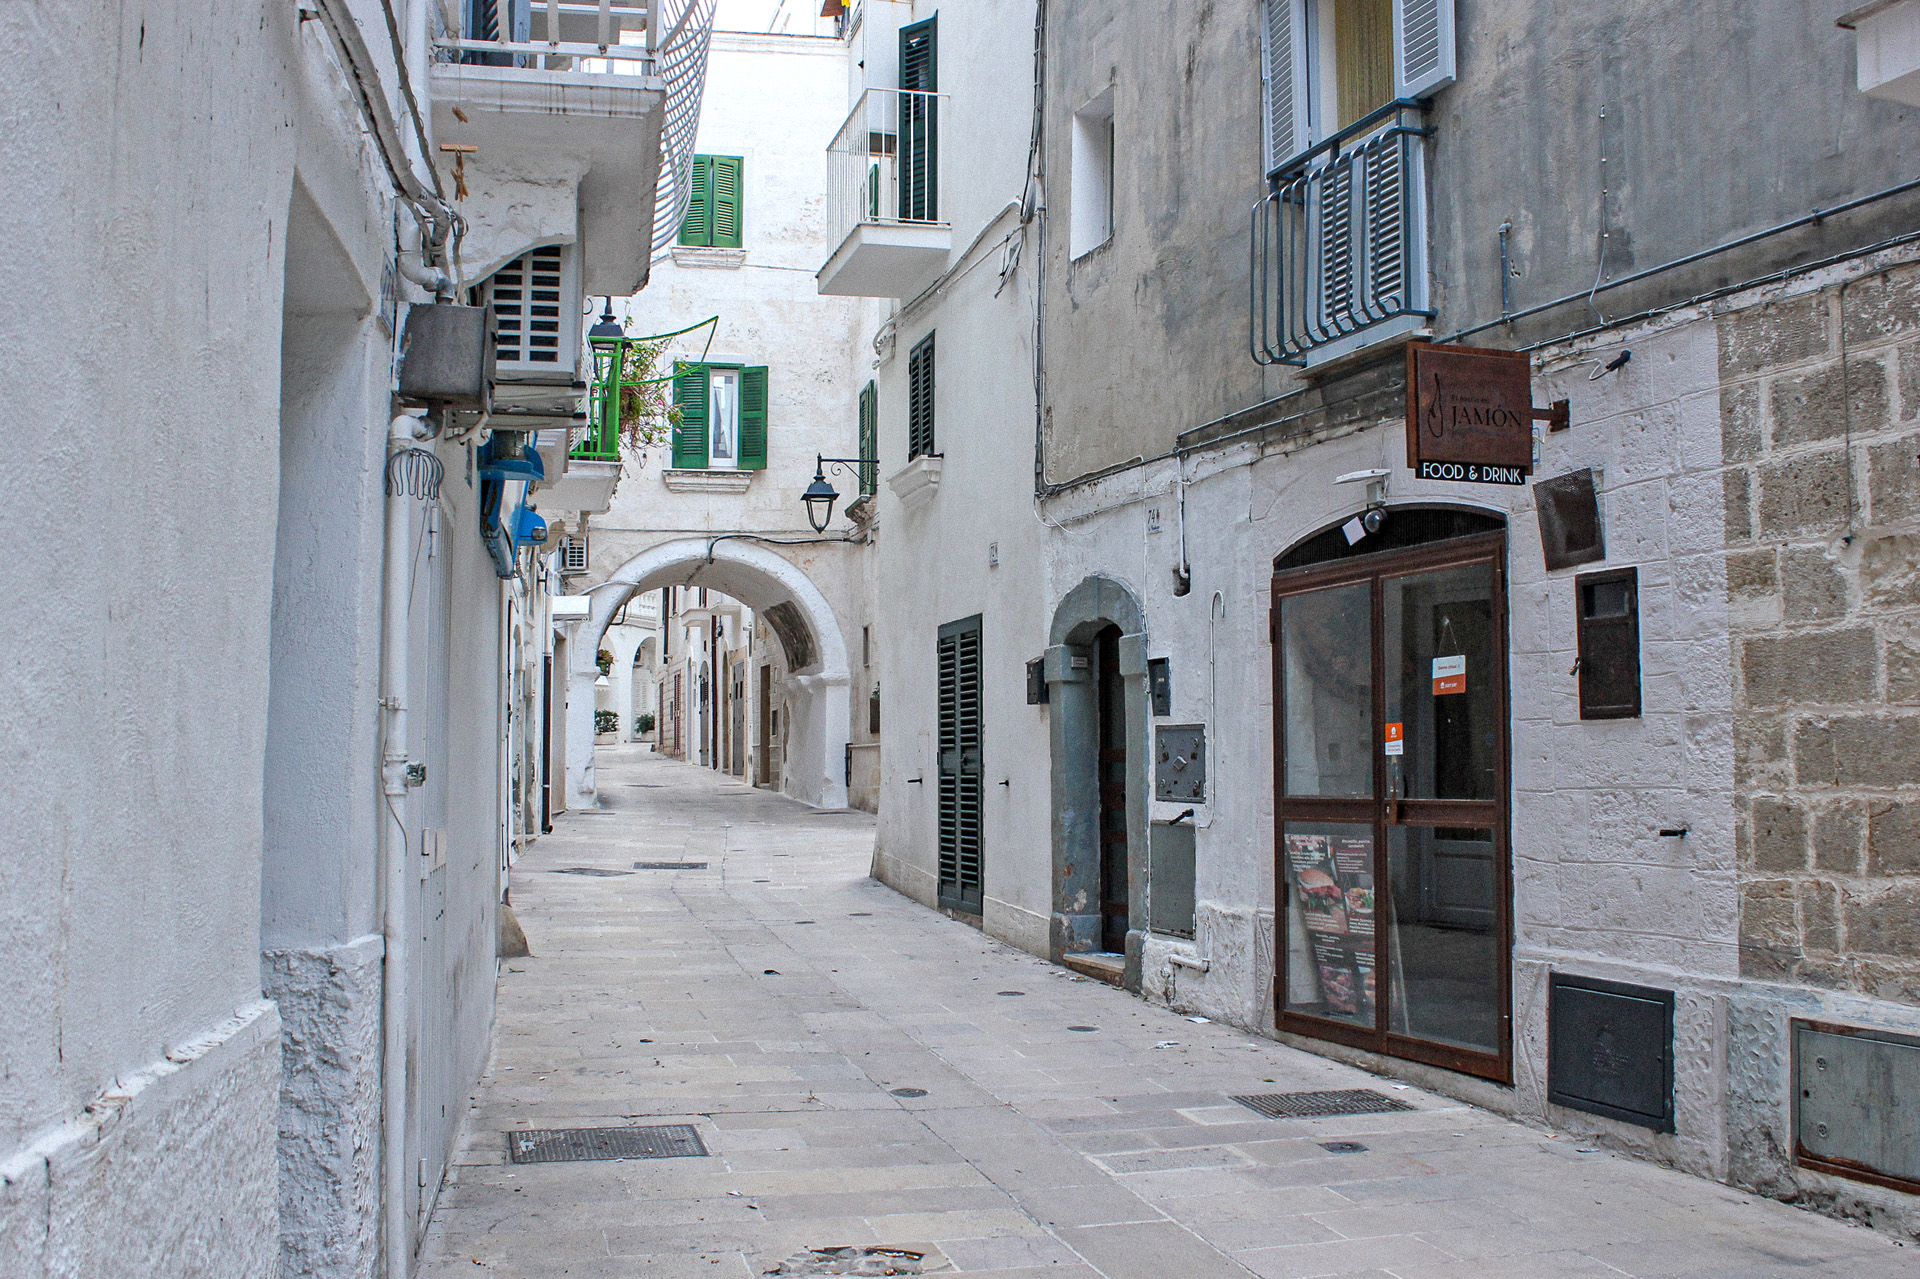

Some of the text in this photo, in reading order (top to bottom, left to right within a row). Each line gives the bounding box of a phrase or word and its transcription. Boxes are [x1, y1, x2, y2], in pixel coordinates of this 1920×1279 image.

[1453, 405, 1521, 427] JAMÓN
[1423, 462, 1522, 483] FOOD & DRINK
